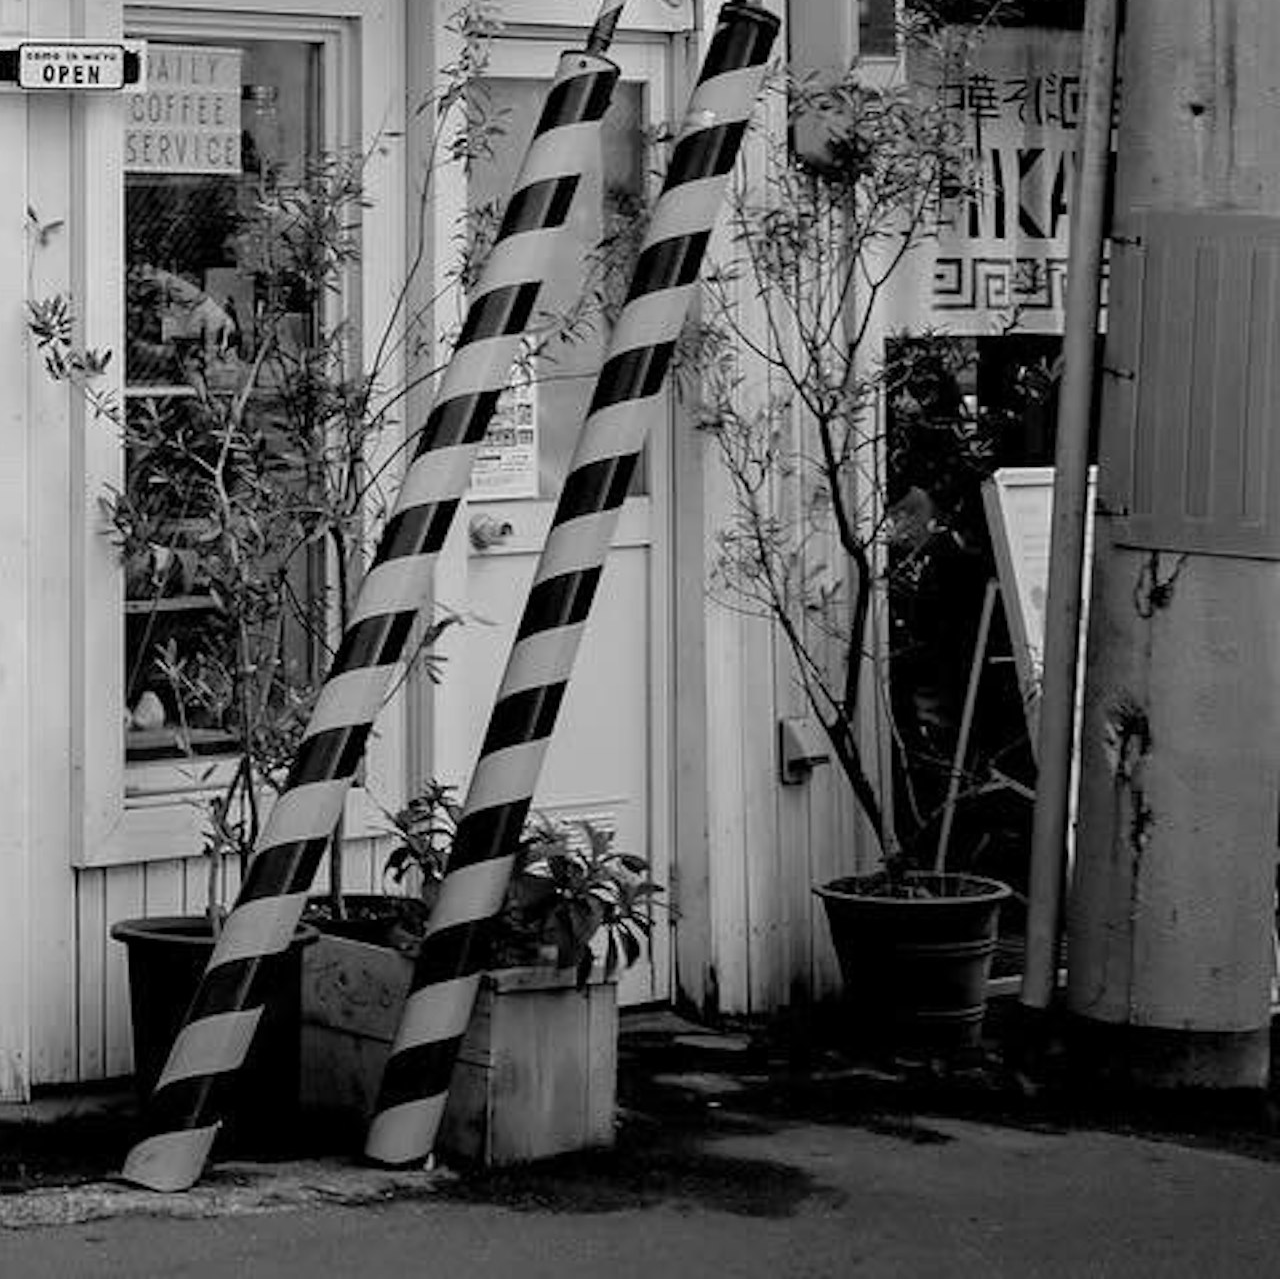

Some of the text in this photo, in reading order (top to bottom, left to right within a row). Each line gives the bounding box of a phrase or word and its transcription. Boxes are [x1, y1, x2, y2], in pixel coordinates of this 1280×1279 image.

[42, 64, 100, 84] OPEN
[130, 92, 226, 126] COFFEE
[124, 131, 236, 167] SERVICE
